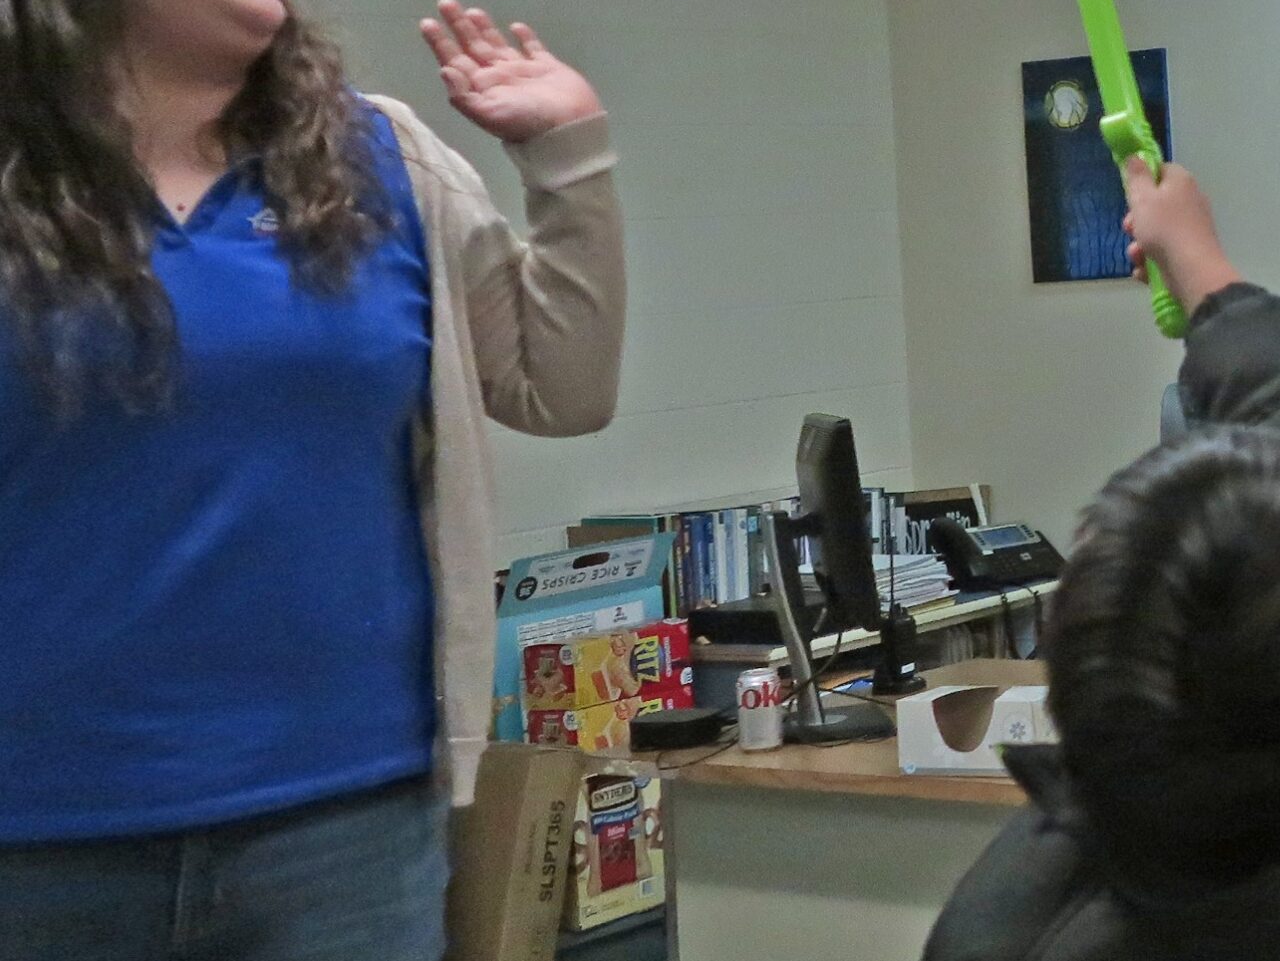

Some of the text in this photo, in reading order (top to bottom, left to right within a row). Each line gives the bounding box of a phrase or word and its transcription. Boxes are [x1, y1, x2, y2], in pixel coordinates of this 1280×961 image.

[541, 572, 587, 591] CRISPS
[591, 564, 620, 581] RICE
[634, 635, 661, 683] RITZ
[538, 799, 566, 903] SLSPT365
